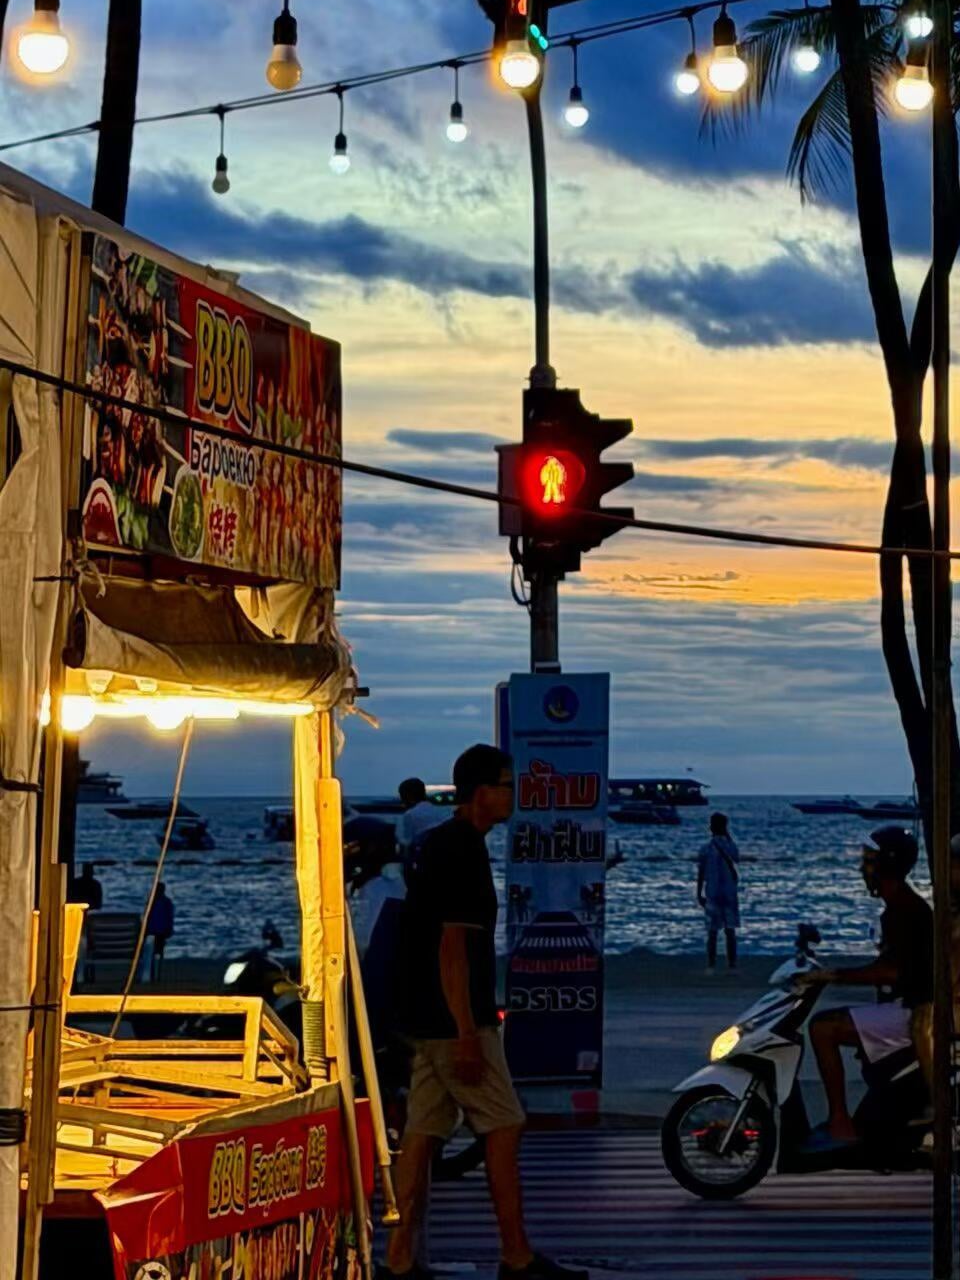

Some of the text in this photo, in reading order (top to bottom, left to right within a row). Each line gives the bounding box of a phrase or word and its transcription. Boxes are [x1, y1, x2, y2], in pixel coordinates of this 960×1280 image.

[196, 299, 252, 434] BBQ
[517, 759, 600, 809] ห้าม
[208, 1137, 245, 1219] BBQ
